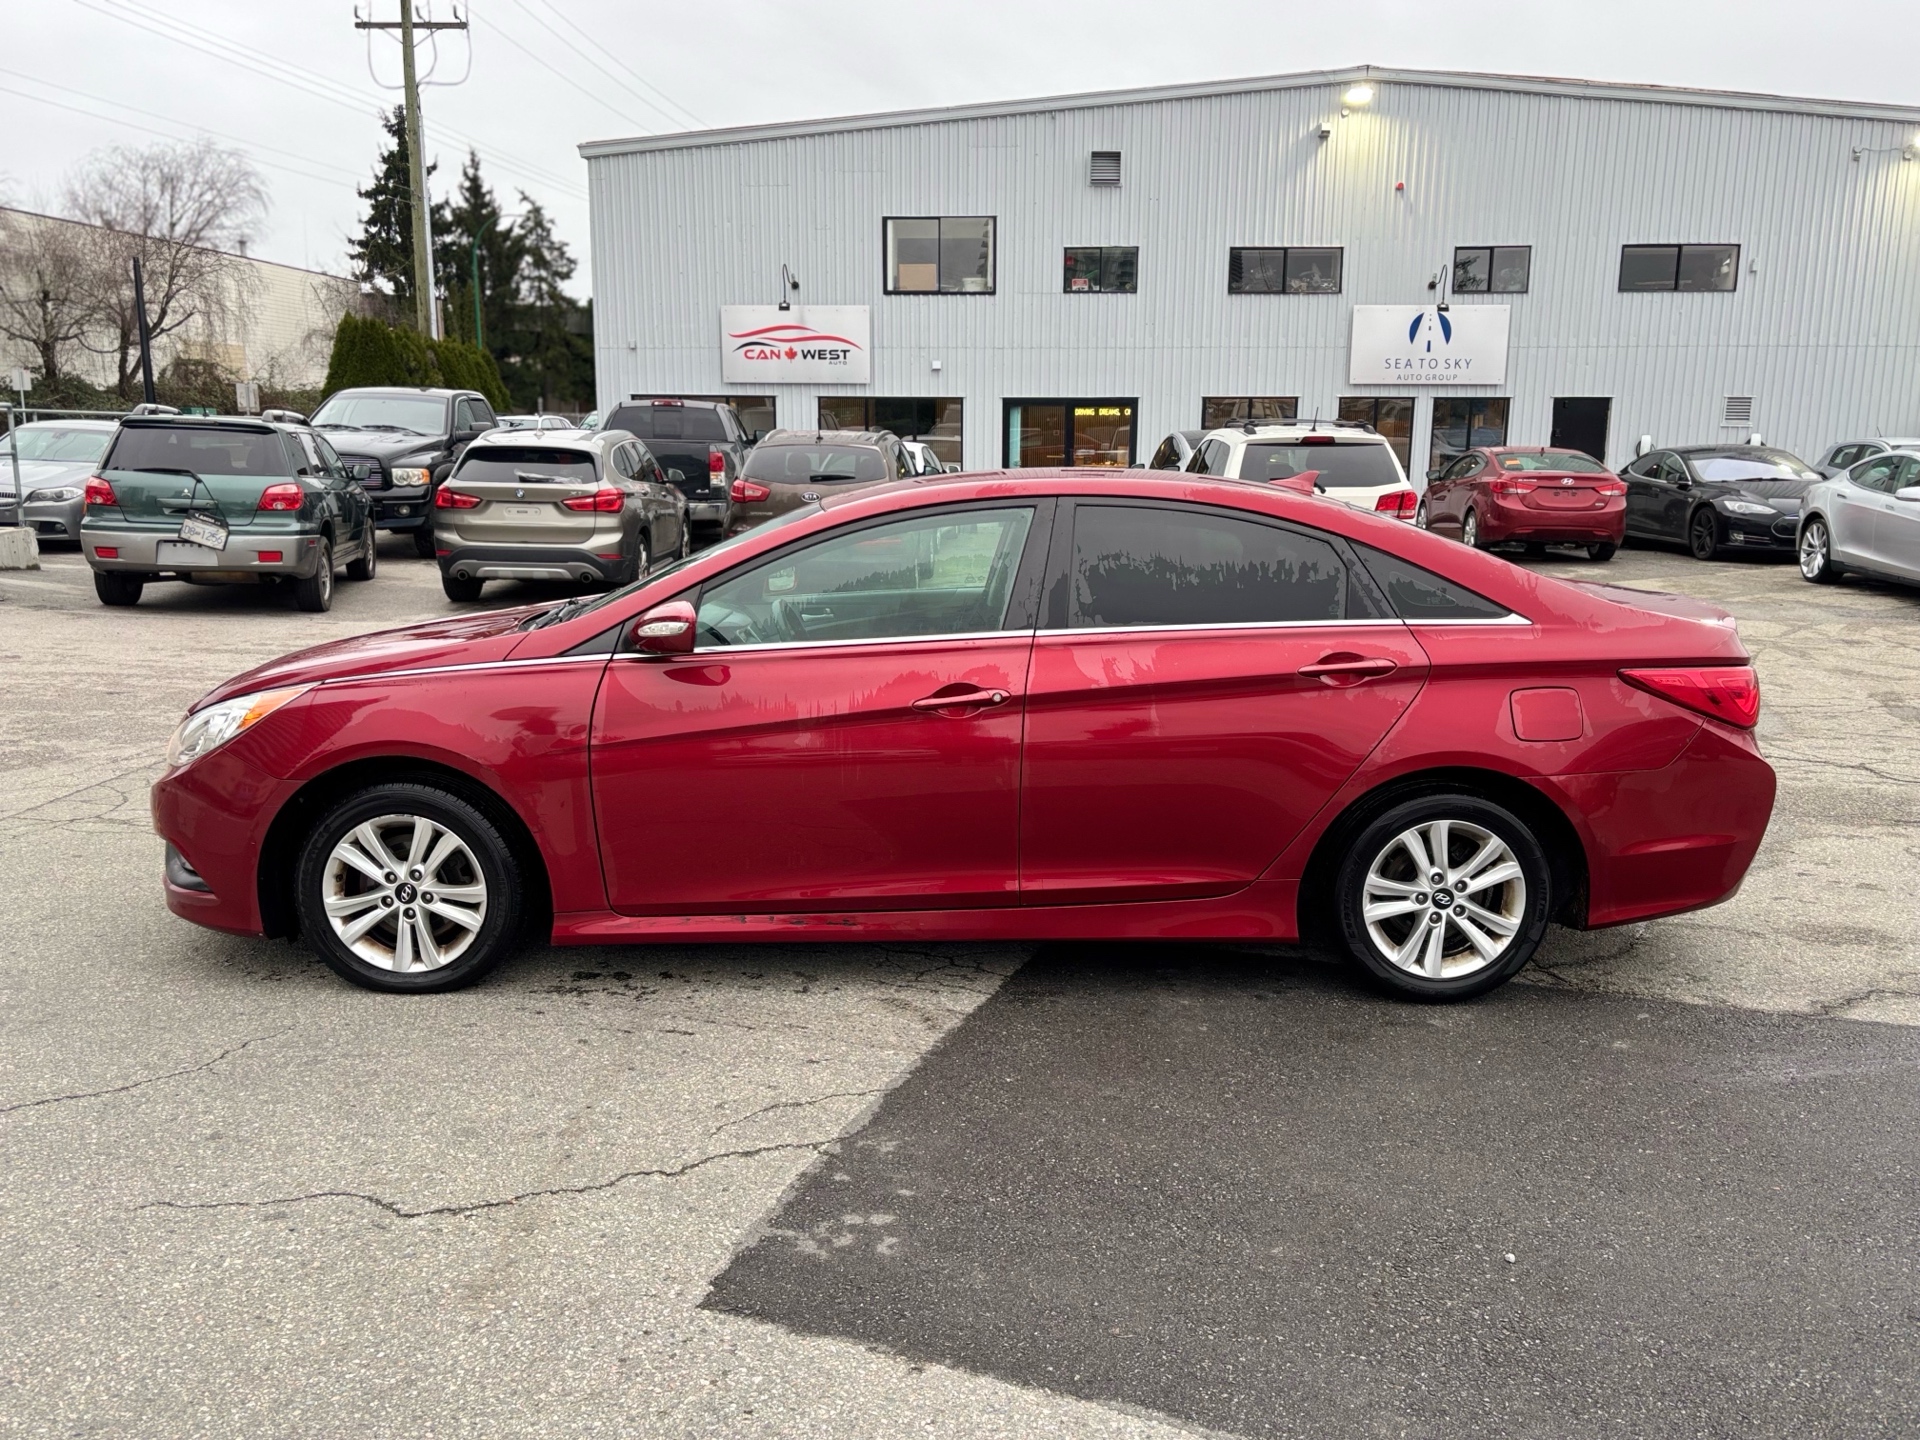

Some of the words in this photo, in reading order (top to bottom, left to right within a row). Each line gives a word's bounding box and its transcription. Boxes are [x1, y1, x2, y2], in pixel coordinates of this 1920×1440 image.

[744, 349, 781, 360] CAN
[801, 349, 851, 360] WEST
[1384, 358, 1413, 370] SEA
[1418, 358, 1439, 370] TO
[1444, 358, 1473, 370] SKY
[1396, 373, 1422, 381] AUTO
[1425, 373, 1458, 381] GROUP
